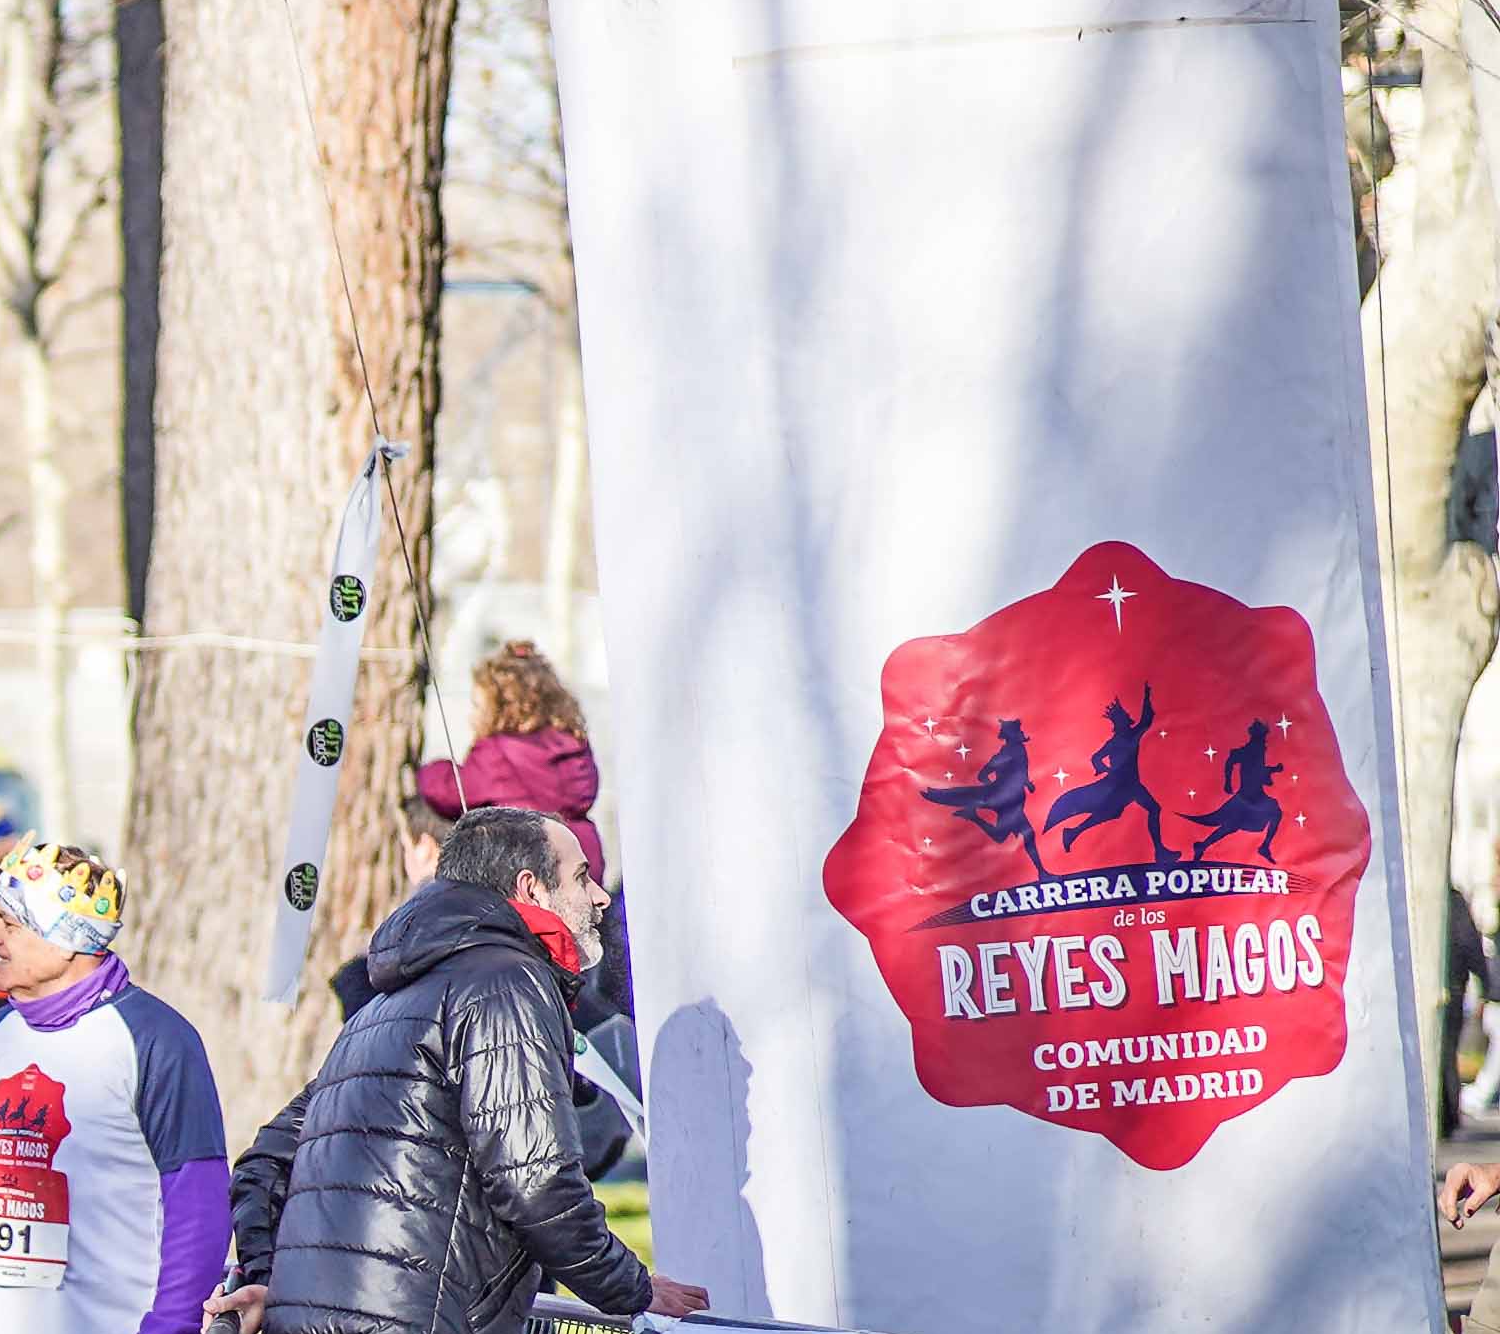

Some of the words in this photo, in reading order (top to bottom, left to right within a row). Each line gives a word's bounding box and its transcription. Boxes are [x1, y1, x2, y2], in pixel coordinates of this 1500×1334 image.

[970, 873, 1138, 919] CARRERA
[1146, 868, 1290, 898] POPULAR
[1113, 908, 1136, 928] de
[1139, 907, 1167, 927] los
[937, 933, 1127, 1020] REYES
[1153, 914, 1325, 1005] MAGOS
[1033, 1025, 1268, 1071] COMUNIDAD
[1047, 1078, 1100, 1112] DE
[1112, 1068, 1264, 1107] MADRID
